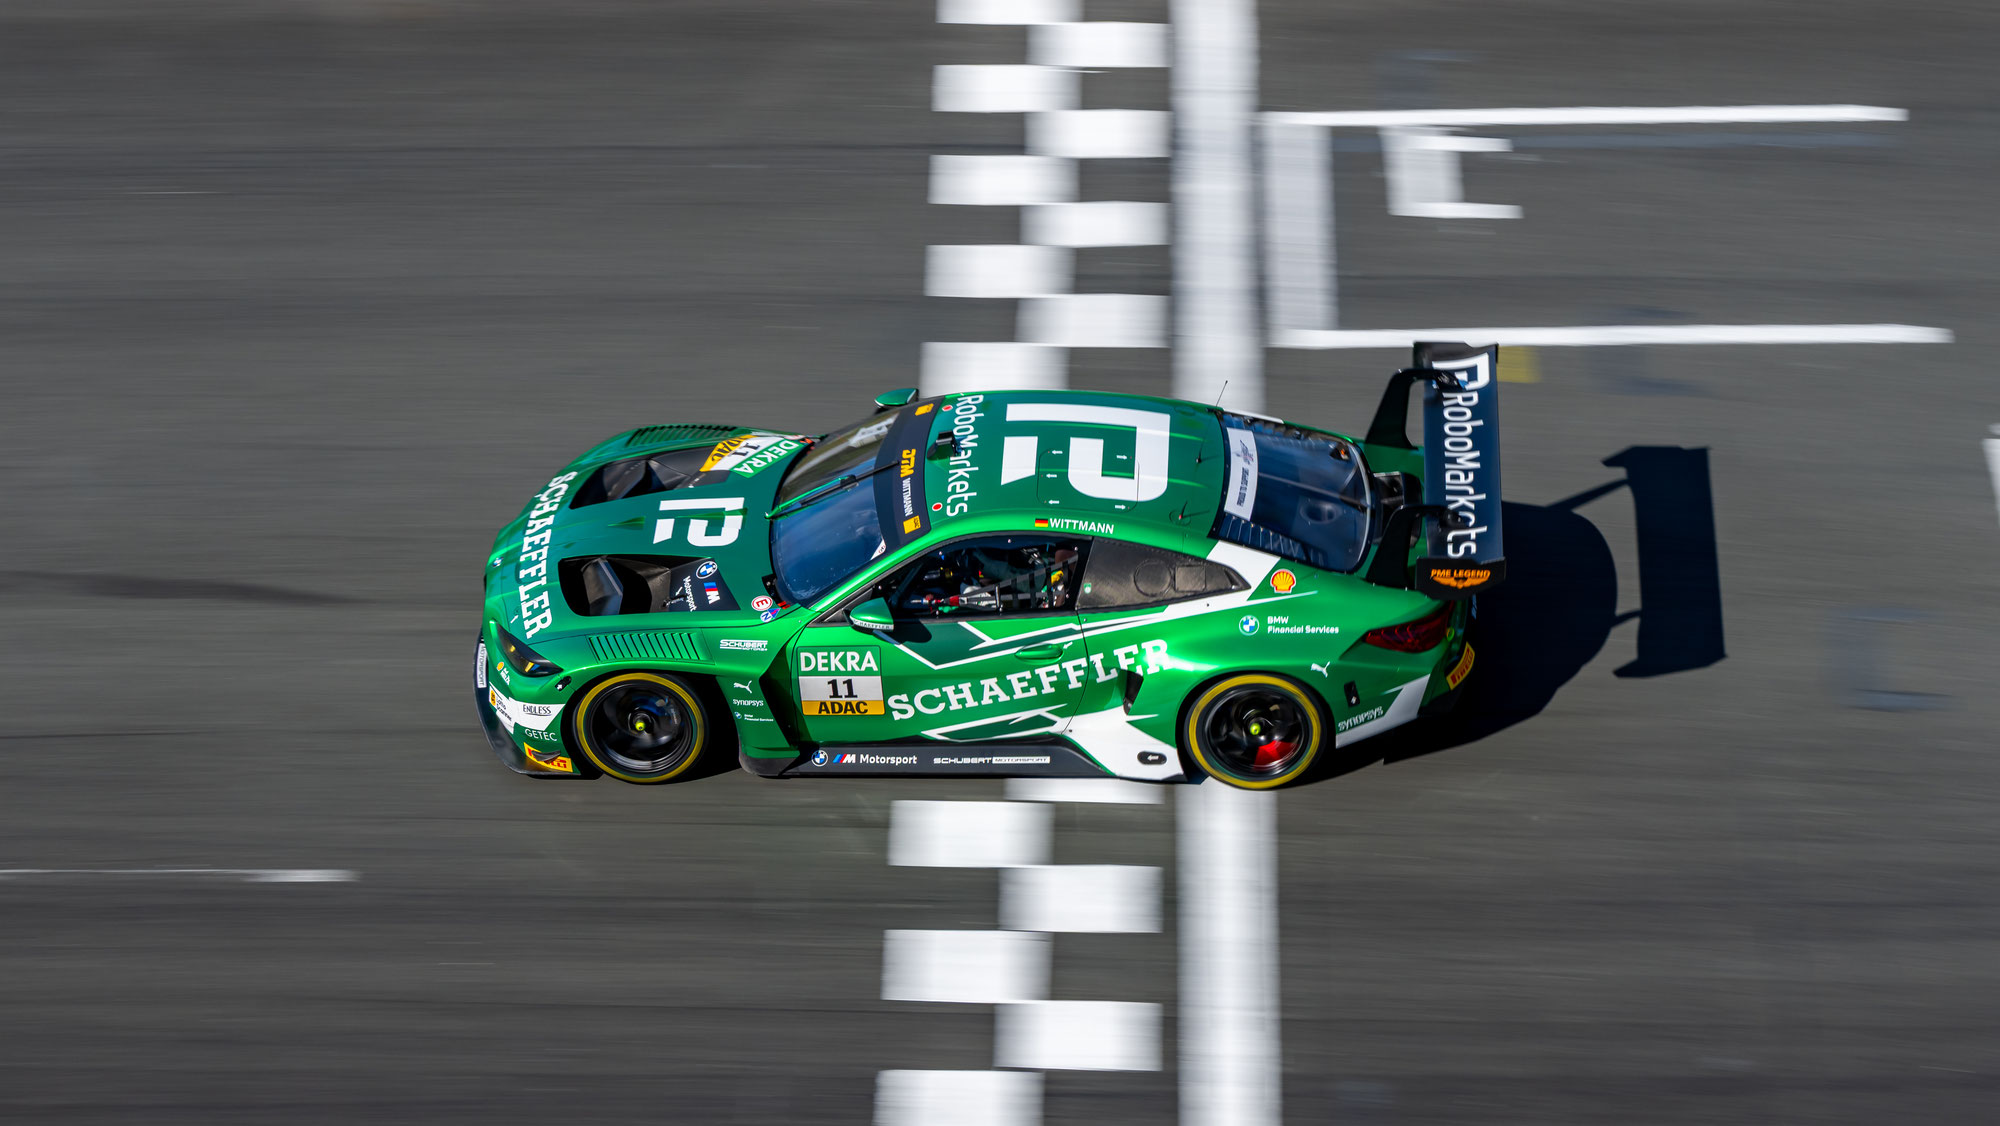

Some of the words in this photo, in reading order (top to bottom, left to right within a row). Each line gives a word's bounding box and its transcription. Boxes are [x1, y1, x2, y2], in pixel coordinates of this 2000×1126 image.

[711, 440, 743, 461] DAC
[729, 442, 760, 457] 11
[734, 440, 799, 474] DEKRA
[946, 394, 985, 517] RoboMarkets
[1050, 518, 1115, 535] WITTMANN
[518, 471, 578, 640] SCHAEFFLER
[1430, 568, 1451, 578] PME
[1453, 568, 1491, 578] LEGEND
[683, 575, 698, 613] Motorsport
[1267, 615, 1290, 625] BMW
[1267, 625, 1304, 634] Financial
[1305, 624, 1340, 634] Services
[800, 651, 879, 672] DEKRA
[888, 638, 1172, 721] SCHAEFFLER
[827, 678, 858, 699] 11
[522, 704, 552, 715] ENDLESS
[818, 701, 869, 715] ADAC
[524, 728, 558, 742] GETEC
[859, 753, 918, 766] Motorsport
[933, 757, 992, 765] SCHUBERT
